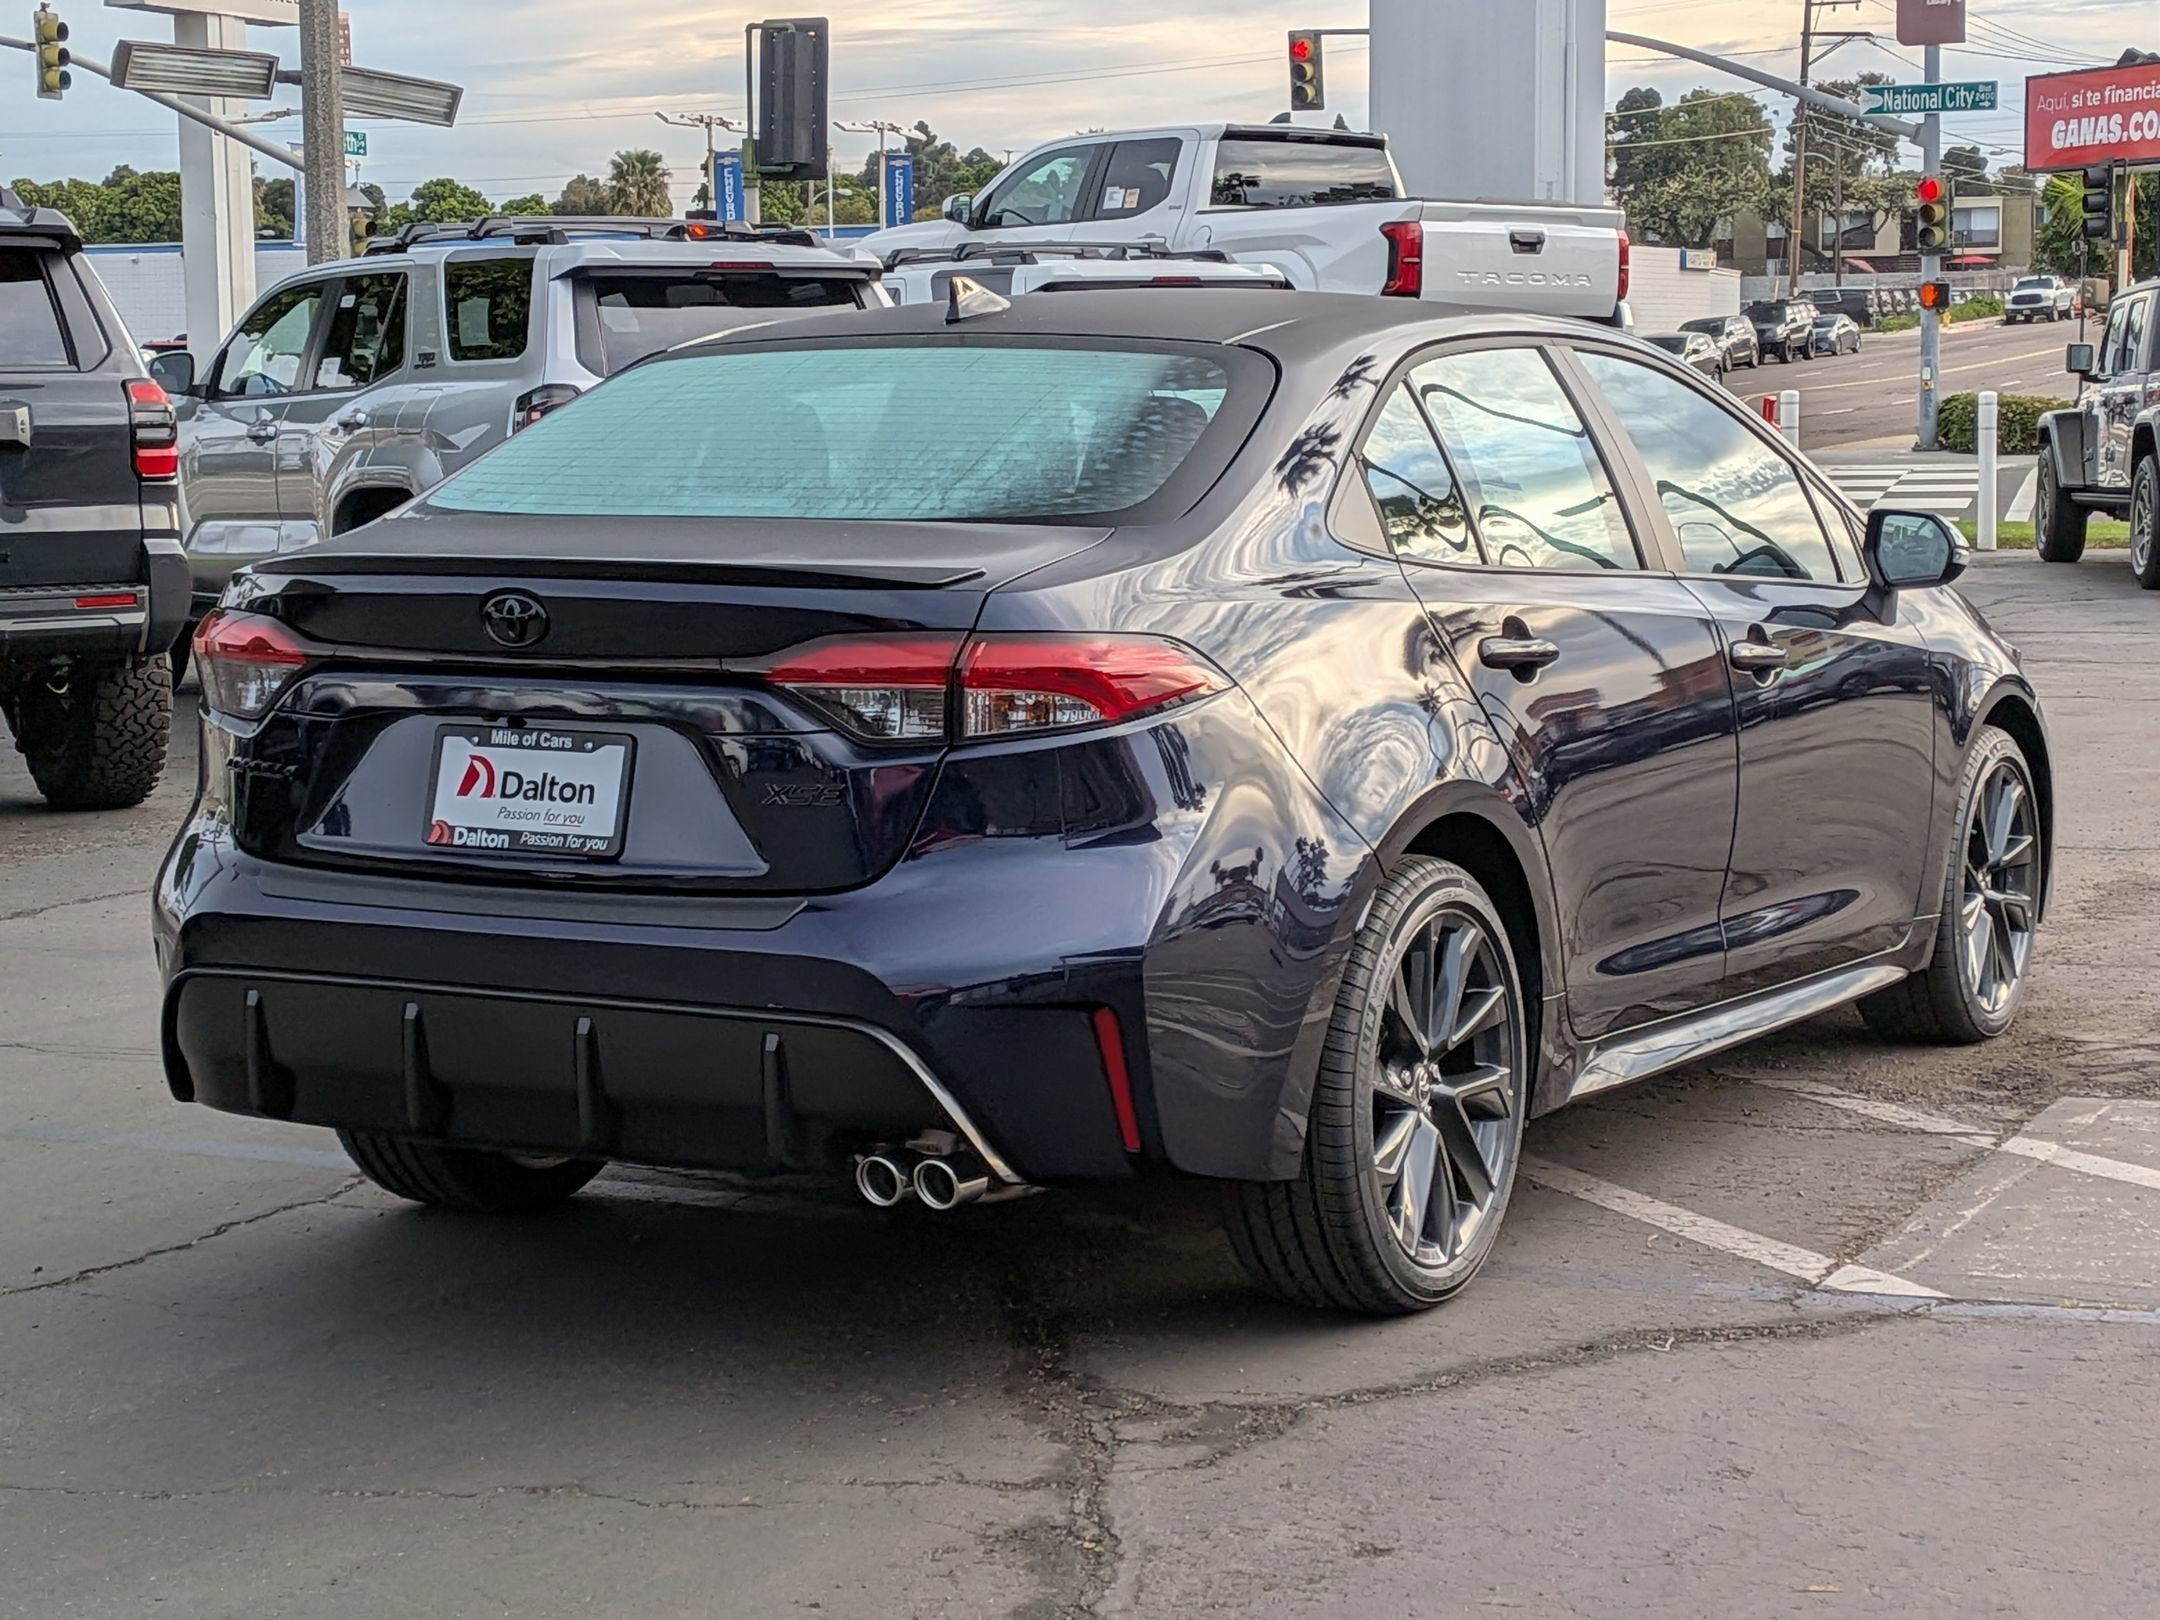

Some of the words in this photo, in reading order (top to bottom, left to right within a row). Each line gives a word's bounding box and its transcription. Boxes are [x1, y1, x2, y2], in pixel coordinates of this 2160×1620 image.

[1883, 88, 1942, 112] National
[1945, 86, 1975, 108] City
[2087, 90, 2101, 106] te
[2051, 110, 2160, 149] GANAS.CO
[343, 132, 357, 153] th
[1457, 271, 1592, 287] TACOMA
[491, 729, 518, 746] Mile
[523, 731, 538, 747] of
[540, 732, 573, 749] Cars
[500, 770, 595, 805] Dalton
[497, 806, 541, 821] Passion
[543, 808, 561, 824] for
[562, 814, 585, 825] you
[453, 827, 509, 848] Dalton
[520, 831, 563, 847] Passion
[564, 834, 584, 850] for
[585, 837, 608, 852] you
